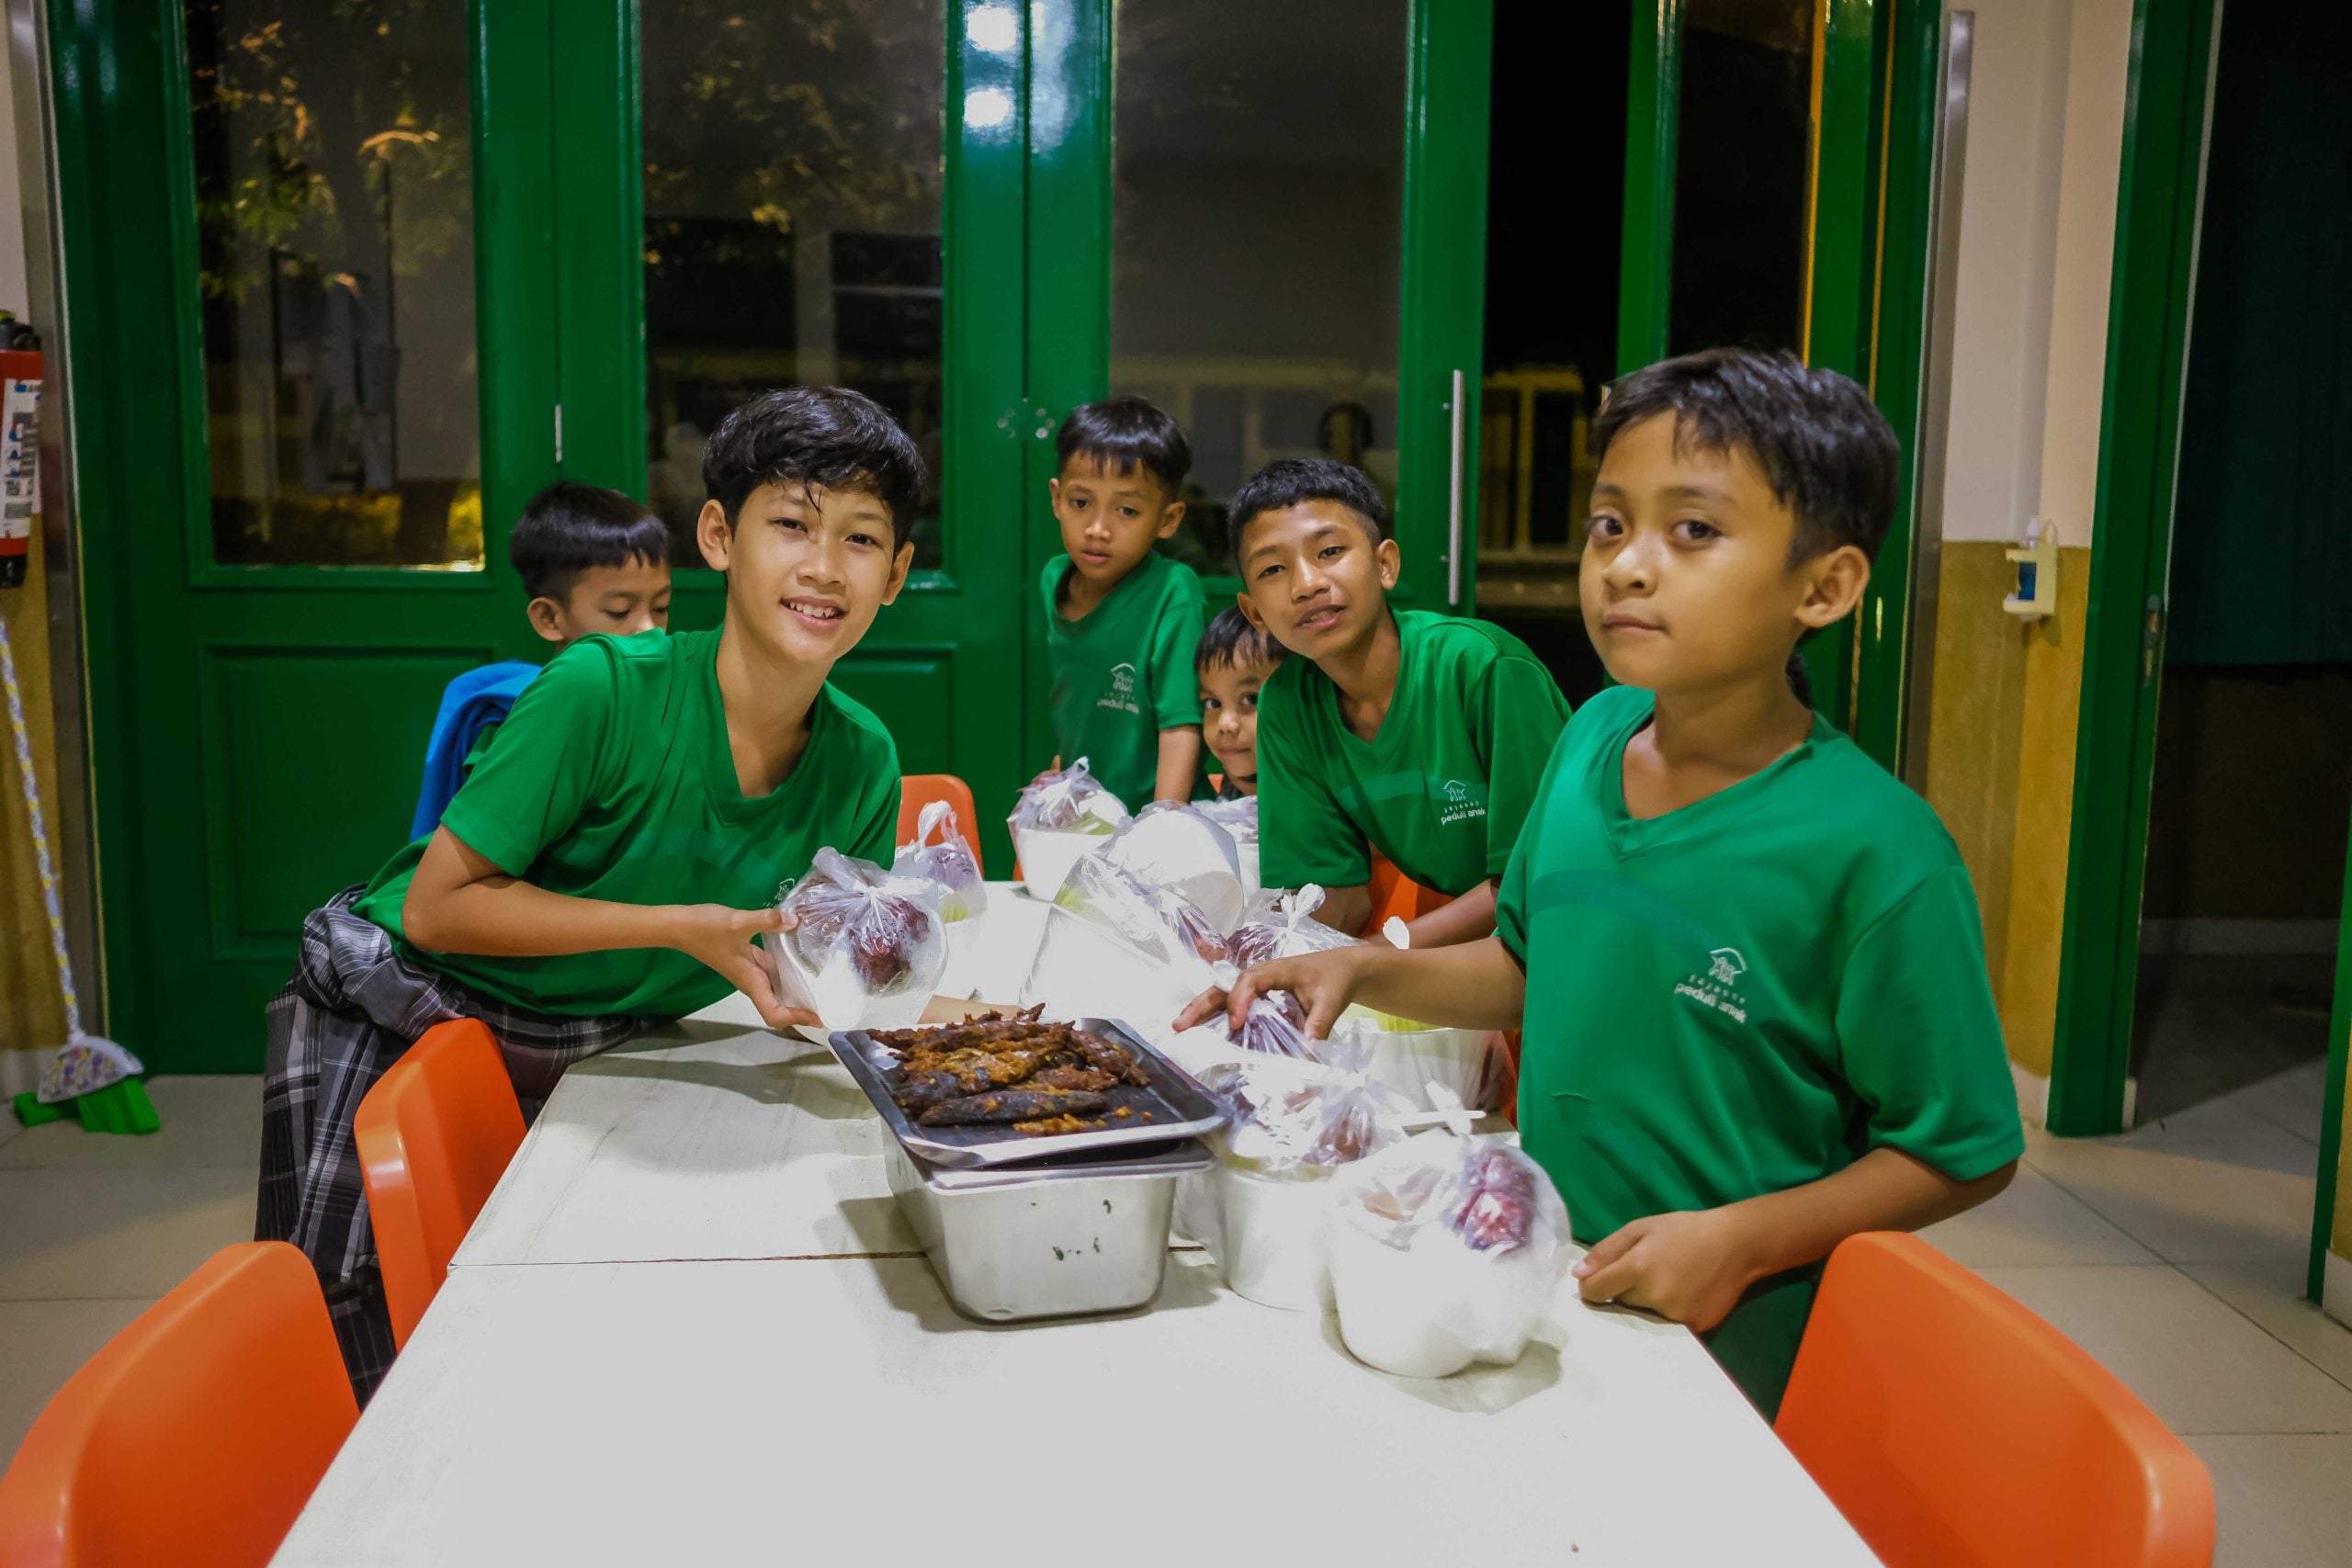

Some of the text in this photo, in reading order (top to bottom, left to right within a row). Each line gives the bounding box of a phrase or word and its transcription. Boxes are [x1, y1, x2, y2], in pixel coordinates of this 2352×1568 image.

[1441, 807, 1486, 826] peduli anak
[1674, 983, 1716, 1007] peduli
